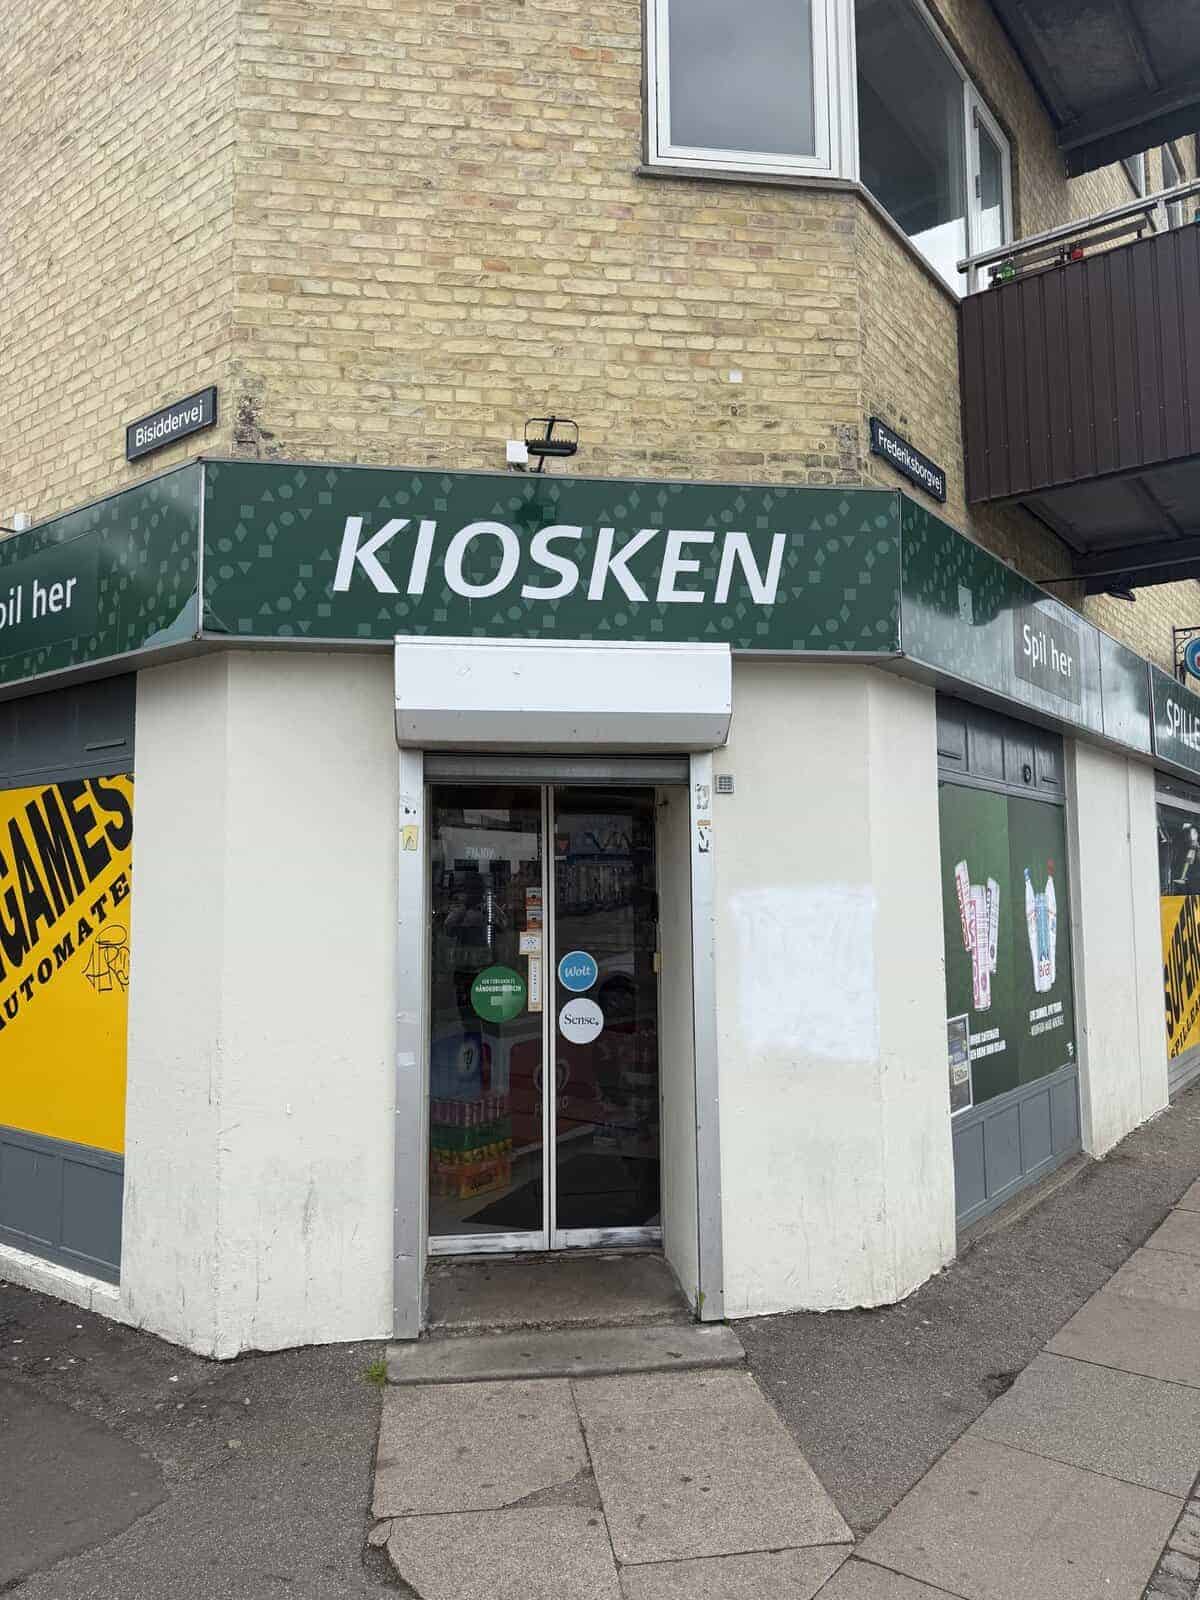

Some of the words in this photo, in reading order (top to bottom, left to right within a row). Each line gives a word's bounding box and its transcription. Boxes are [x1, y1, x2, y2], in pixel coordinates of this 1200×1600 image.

[135, 399, 203, 447] Bisiddervej
[878, 428, 943, 494] Frederiksborgvej
[332, 516, 787, 605] KIOSKEN
[32, 577, 77, 618] her
[1023, 623, 1047, 668] Spil
[1050, 638, 1073, 677] her
[0, 774, 134, 983] GAMES
[0, 864, 133, 1031] UTOMATE
[564, 965, 593, 978] Wolt
